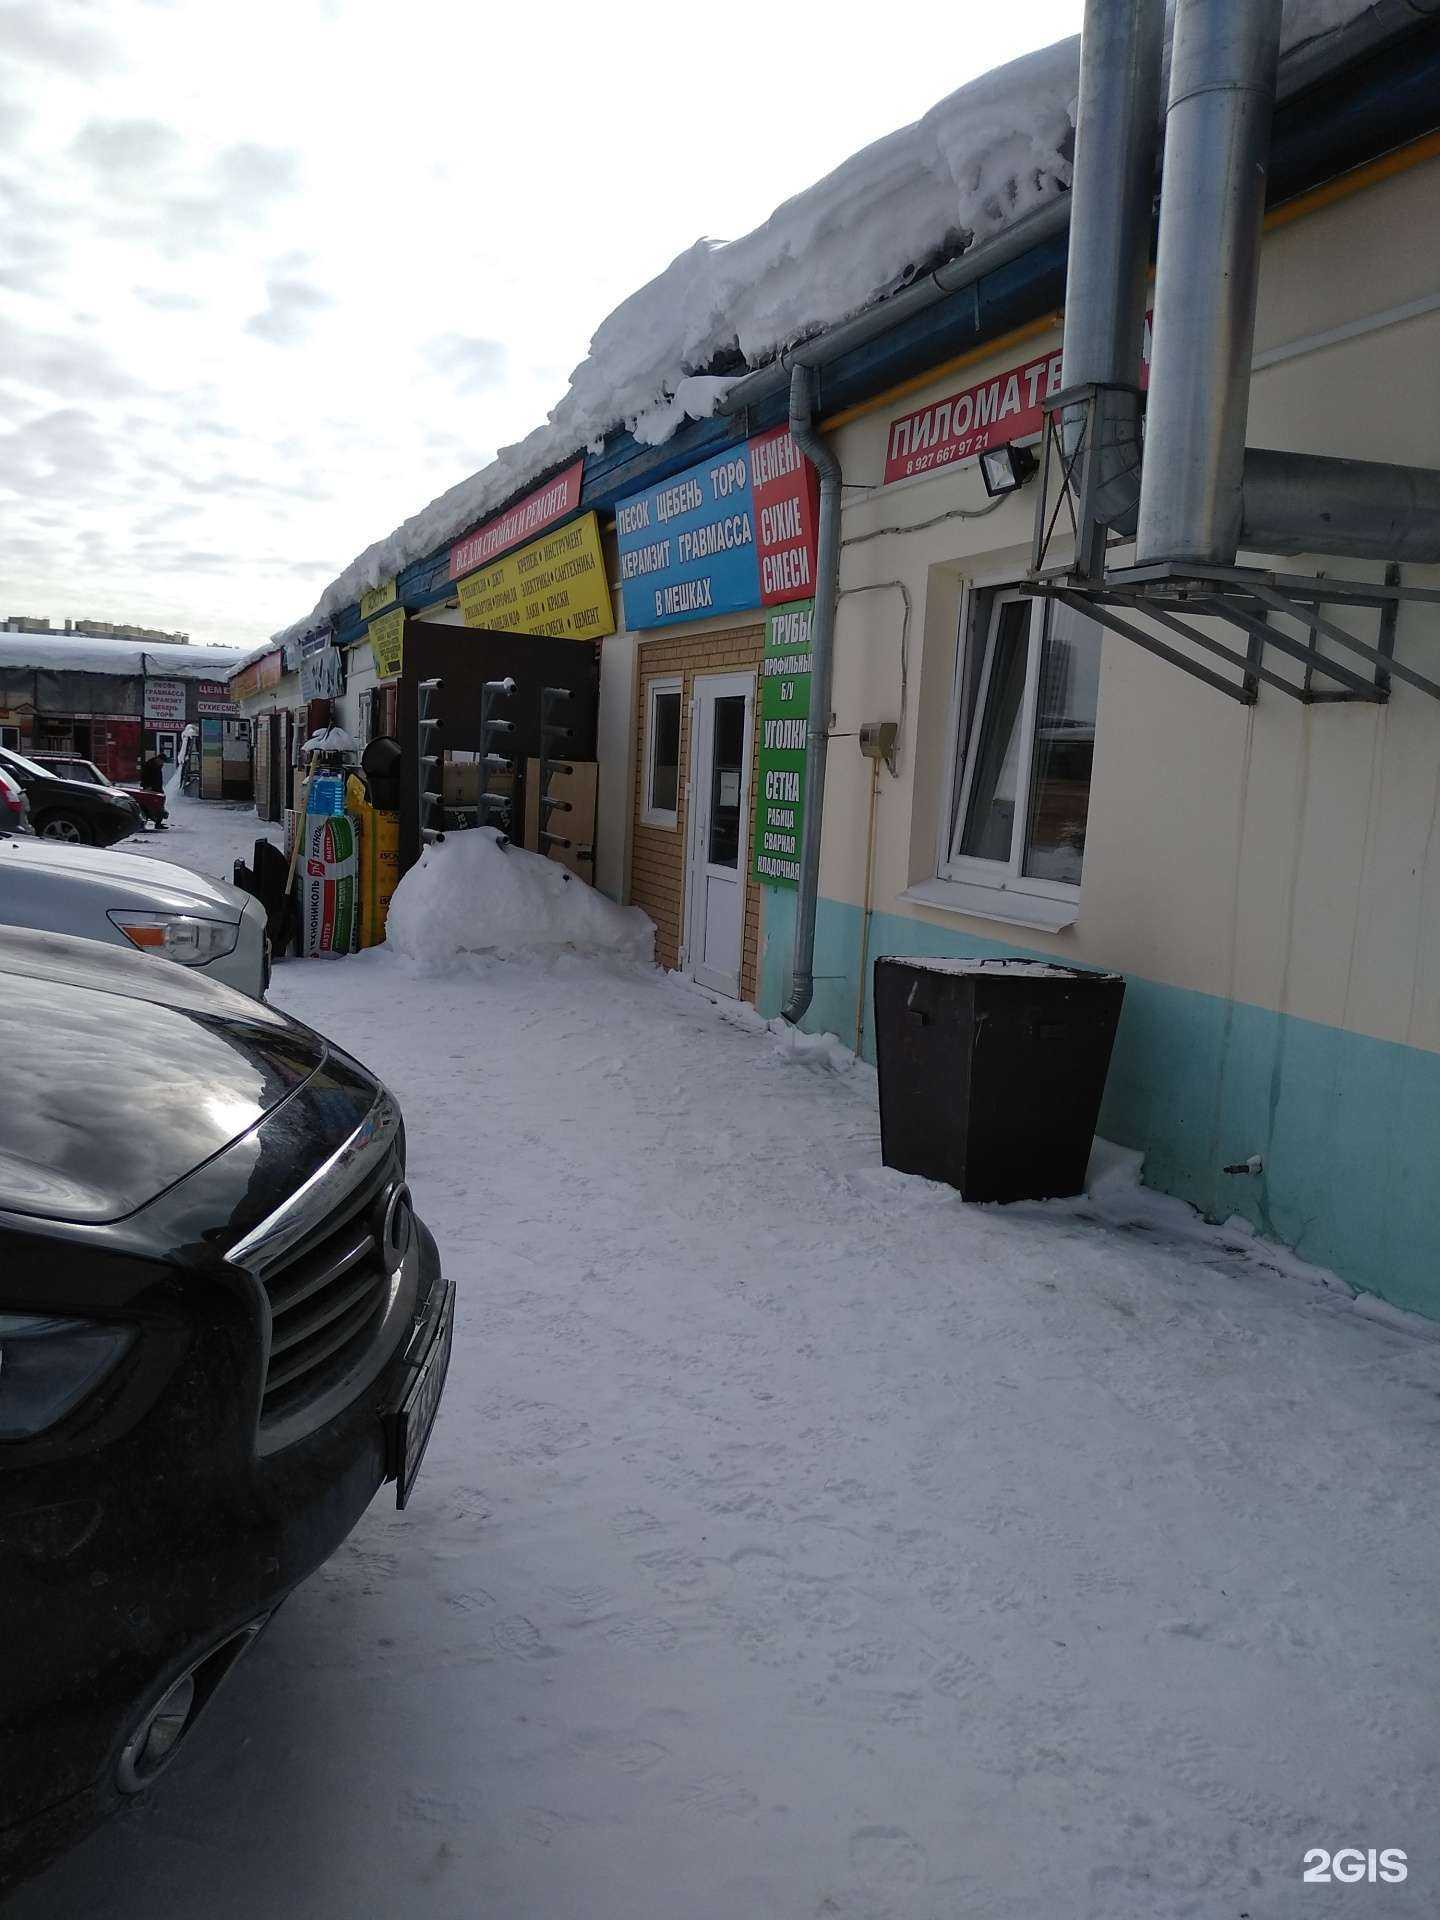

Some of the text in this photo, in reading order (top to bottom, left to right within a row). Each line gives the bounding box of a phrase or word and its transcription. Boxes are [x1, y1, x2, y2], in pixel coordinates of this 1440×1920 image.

[891, 354, 1063, 460] ПИЛОМАТЕ
[906, 432, 989, 474] 8 927 667 97 21
[618, 459, 746, 535] ПЕСОК ЩЕБЕНЬ ТОРФ
[482, 514, 518, 556] СТРОЙКИ
[526, 480, 568, 530] РЕМОНТА
[761, 497, 802, 546] СУХИЕ
[516, 551, 540, 575] КРЕПЕЖ
[543, 528, 583, 561] ИНСТРУМЕНТ
[621, 512, 752, 579] КЕРАМЗИТ ГРАВМАССА
[521, 572, 551, 597] ЭЛЕКТРИКА
[554, 552, 596, 583] САНТЕХНИКА
[763, 546, 810, 594] СМЕСИ
[526, 602, 540, 620] ЛАКИ
[547, 590, 570, 612] КРАСКИ
[655, 577, 712, 616] В МЕШКАХ
[572, 606, 601, 629] ЦЕМЕНТ
[771, 609, 813, 645] ТРУБЫ
[199, 685, 231, 695] ЦЕМЕ
[199, 703, 221, 711] СУХИЕ
[781, 682, 794, 700] Б/У
[764, 719, 807, 749] УГОЛКИ
[766, 770, 800, 801] СЕТКА
[767, 808, 794, 829] РАБИЦА
[764, 832, 795, 854] СВАРНАЯ
[758, 855, 800, 880] КЛАДОЧНАЯ
